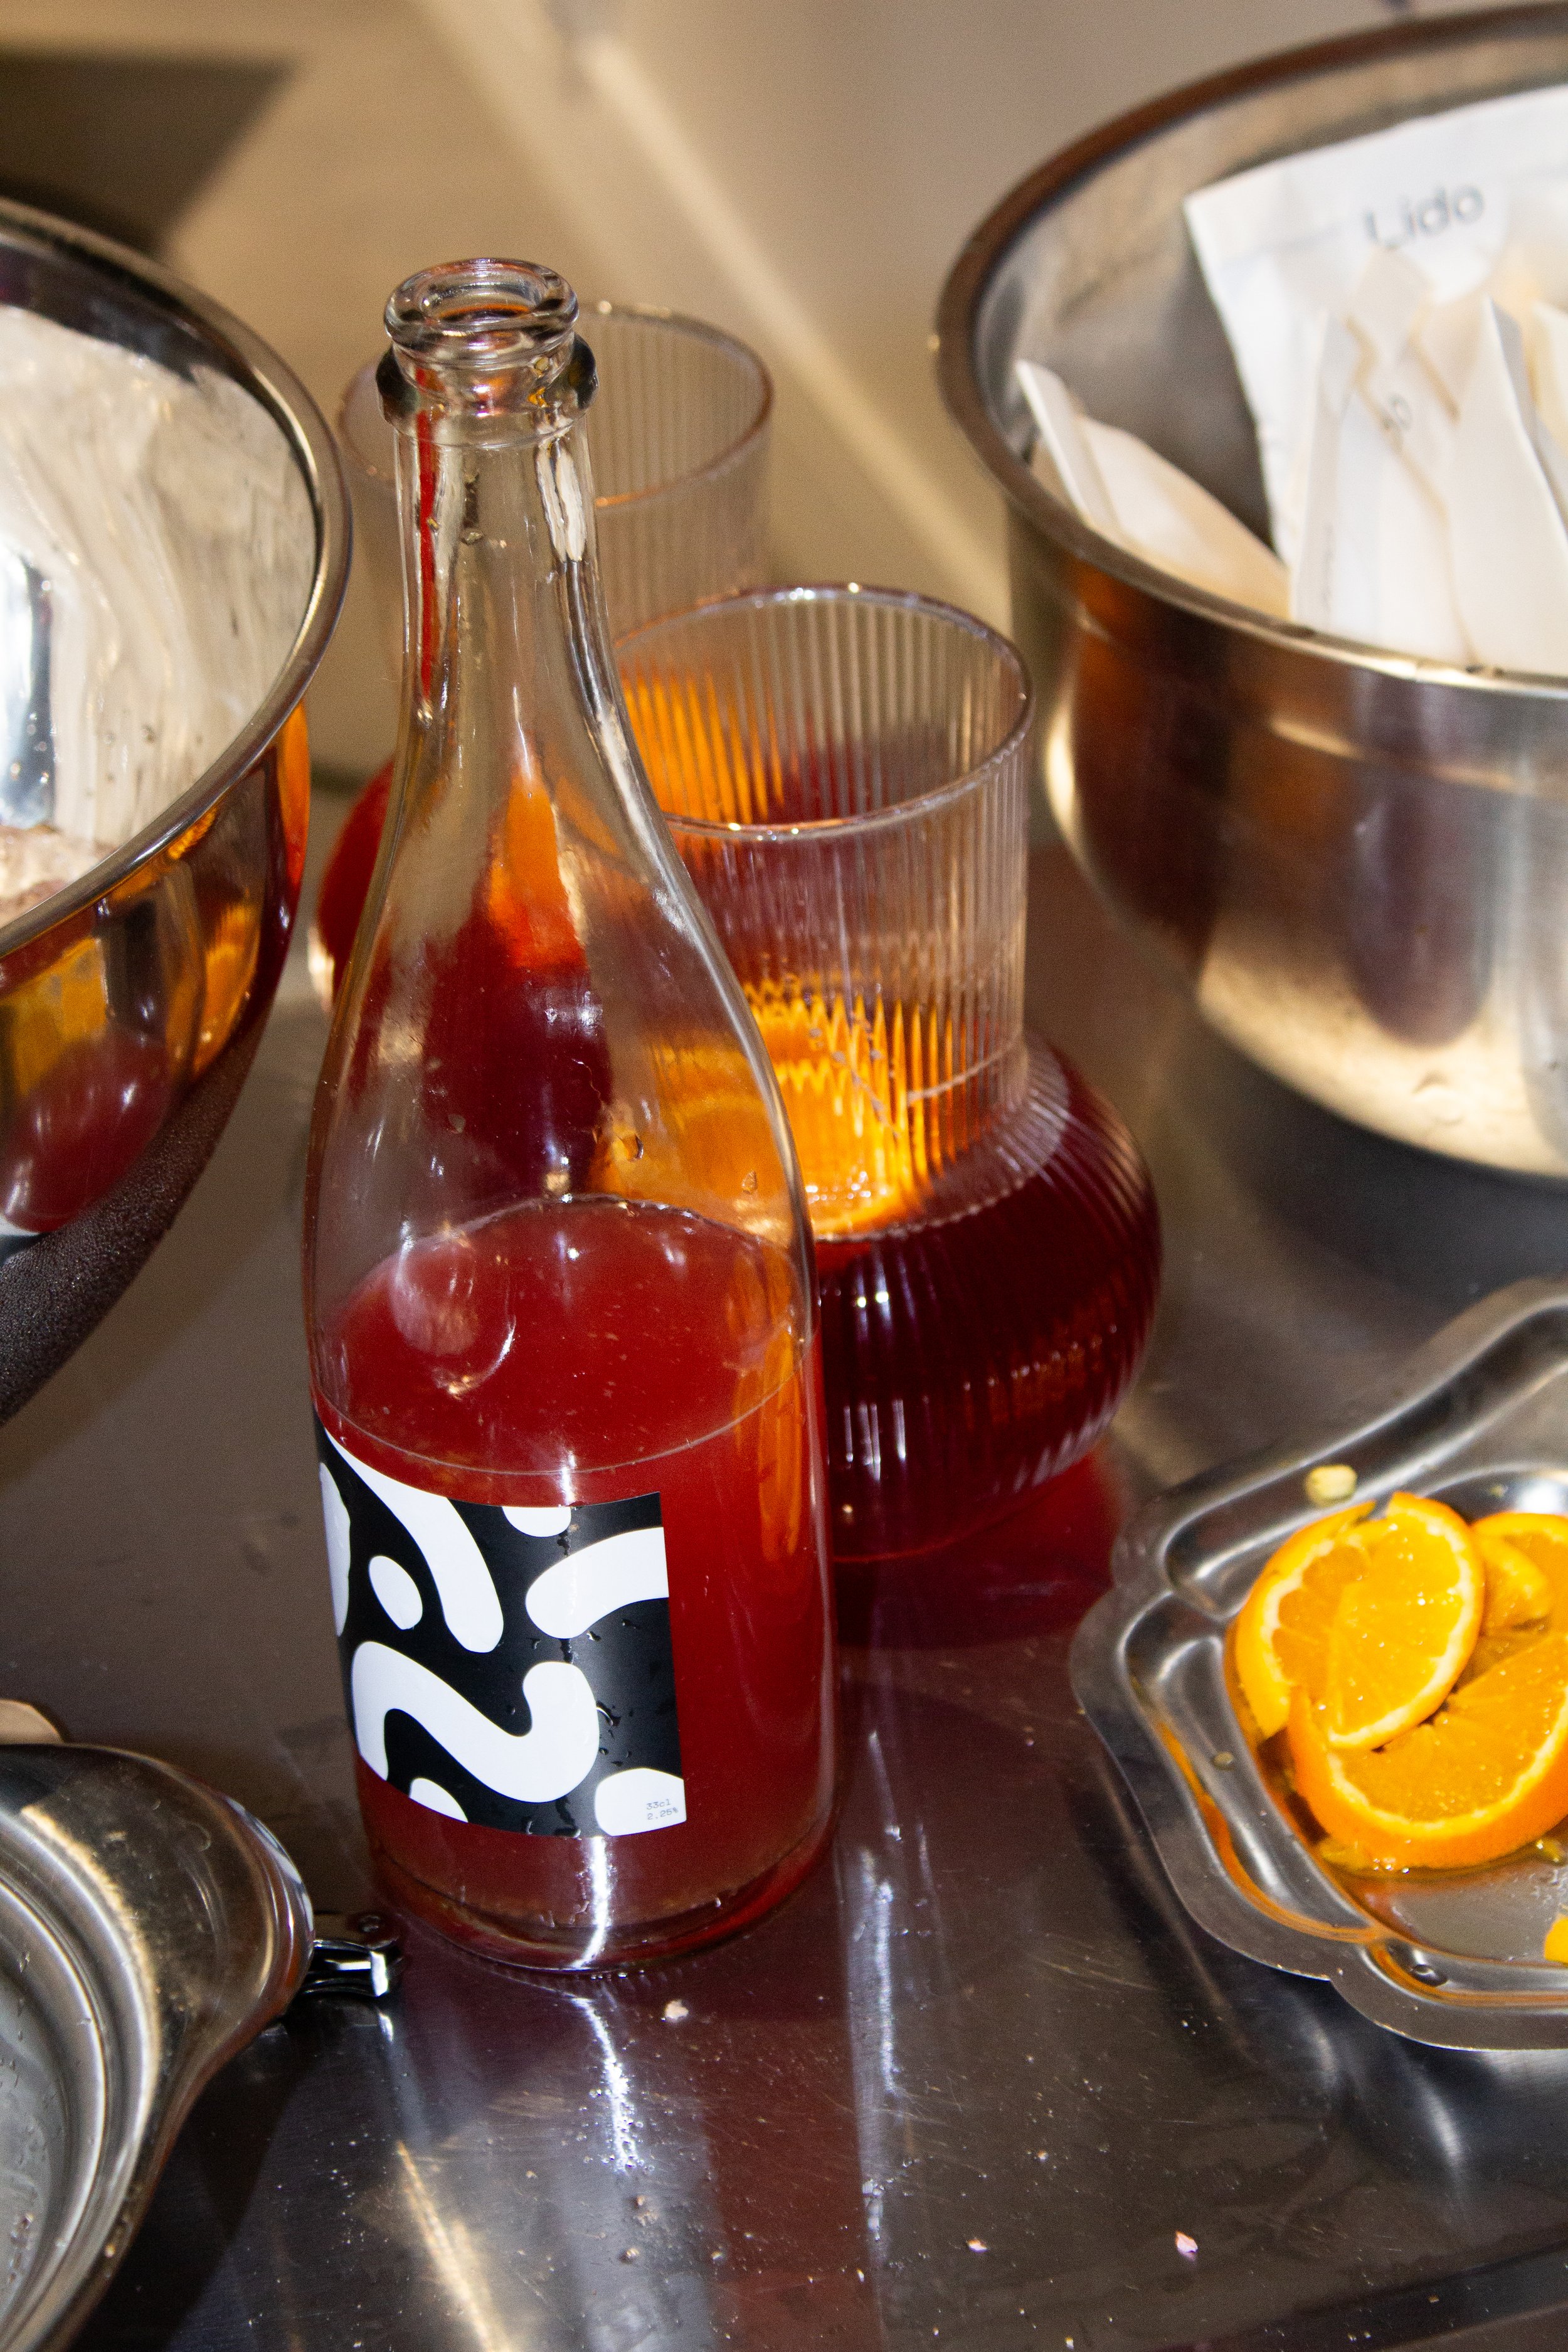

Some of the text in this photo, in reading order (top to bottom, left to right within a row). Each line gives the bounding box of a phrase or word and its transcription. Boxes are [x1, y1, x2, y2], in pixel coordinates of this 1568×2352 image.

[1362, 183, 1485, 249] Lido
[646, 1798, 671, 1810] 33cl
[647, 1807, 679, 1820] 2.25%
